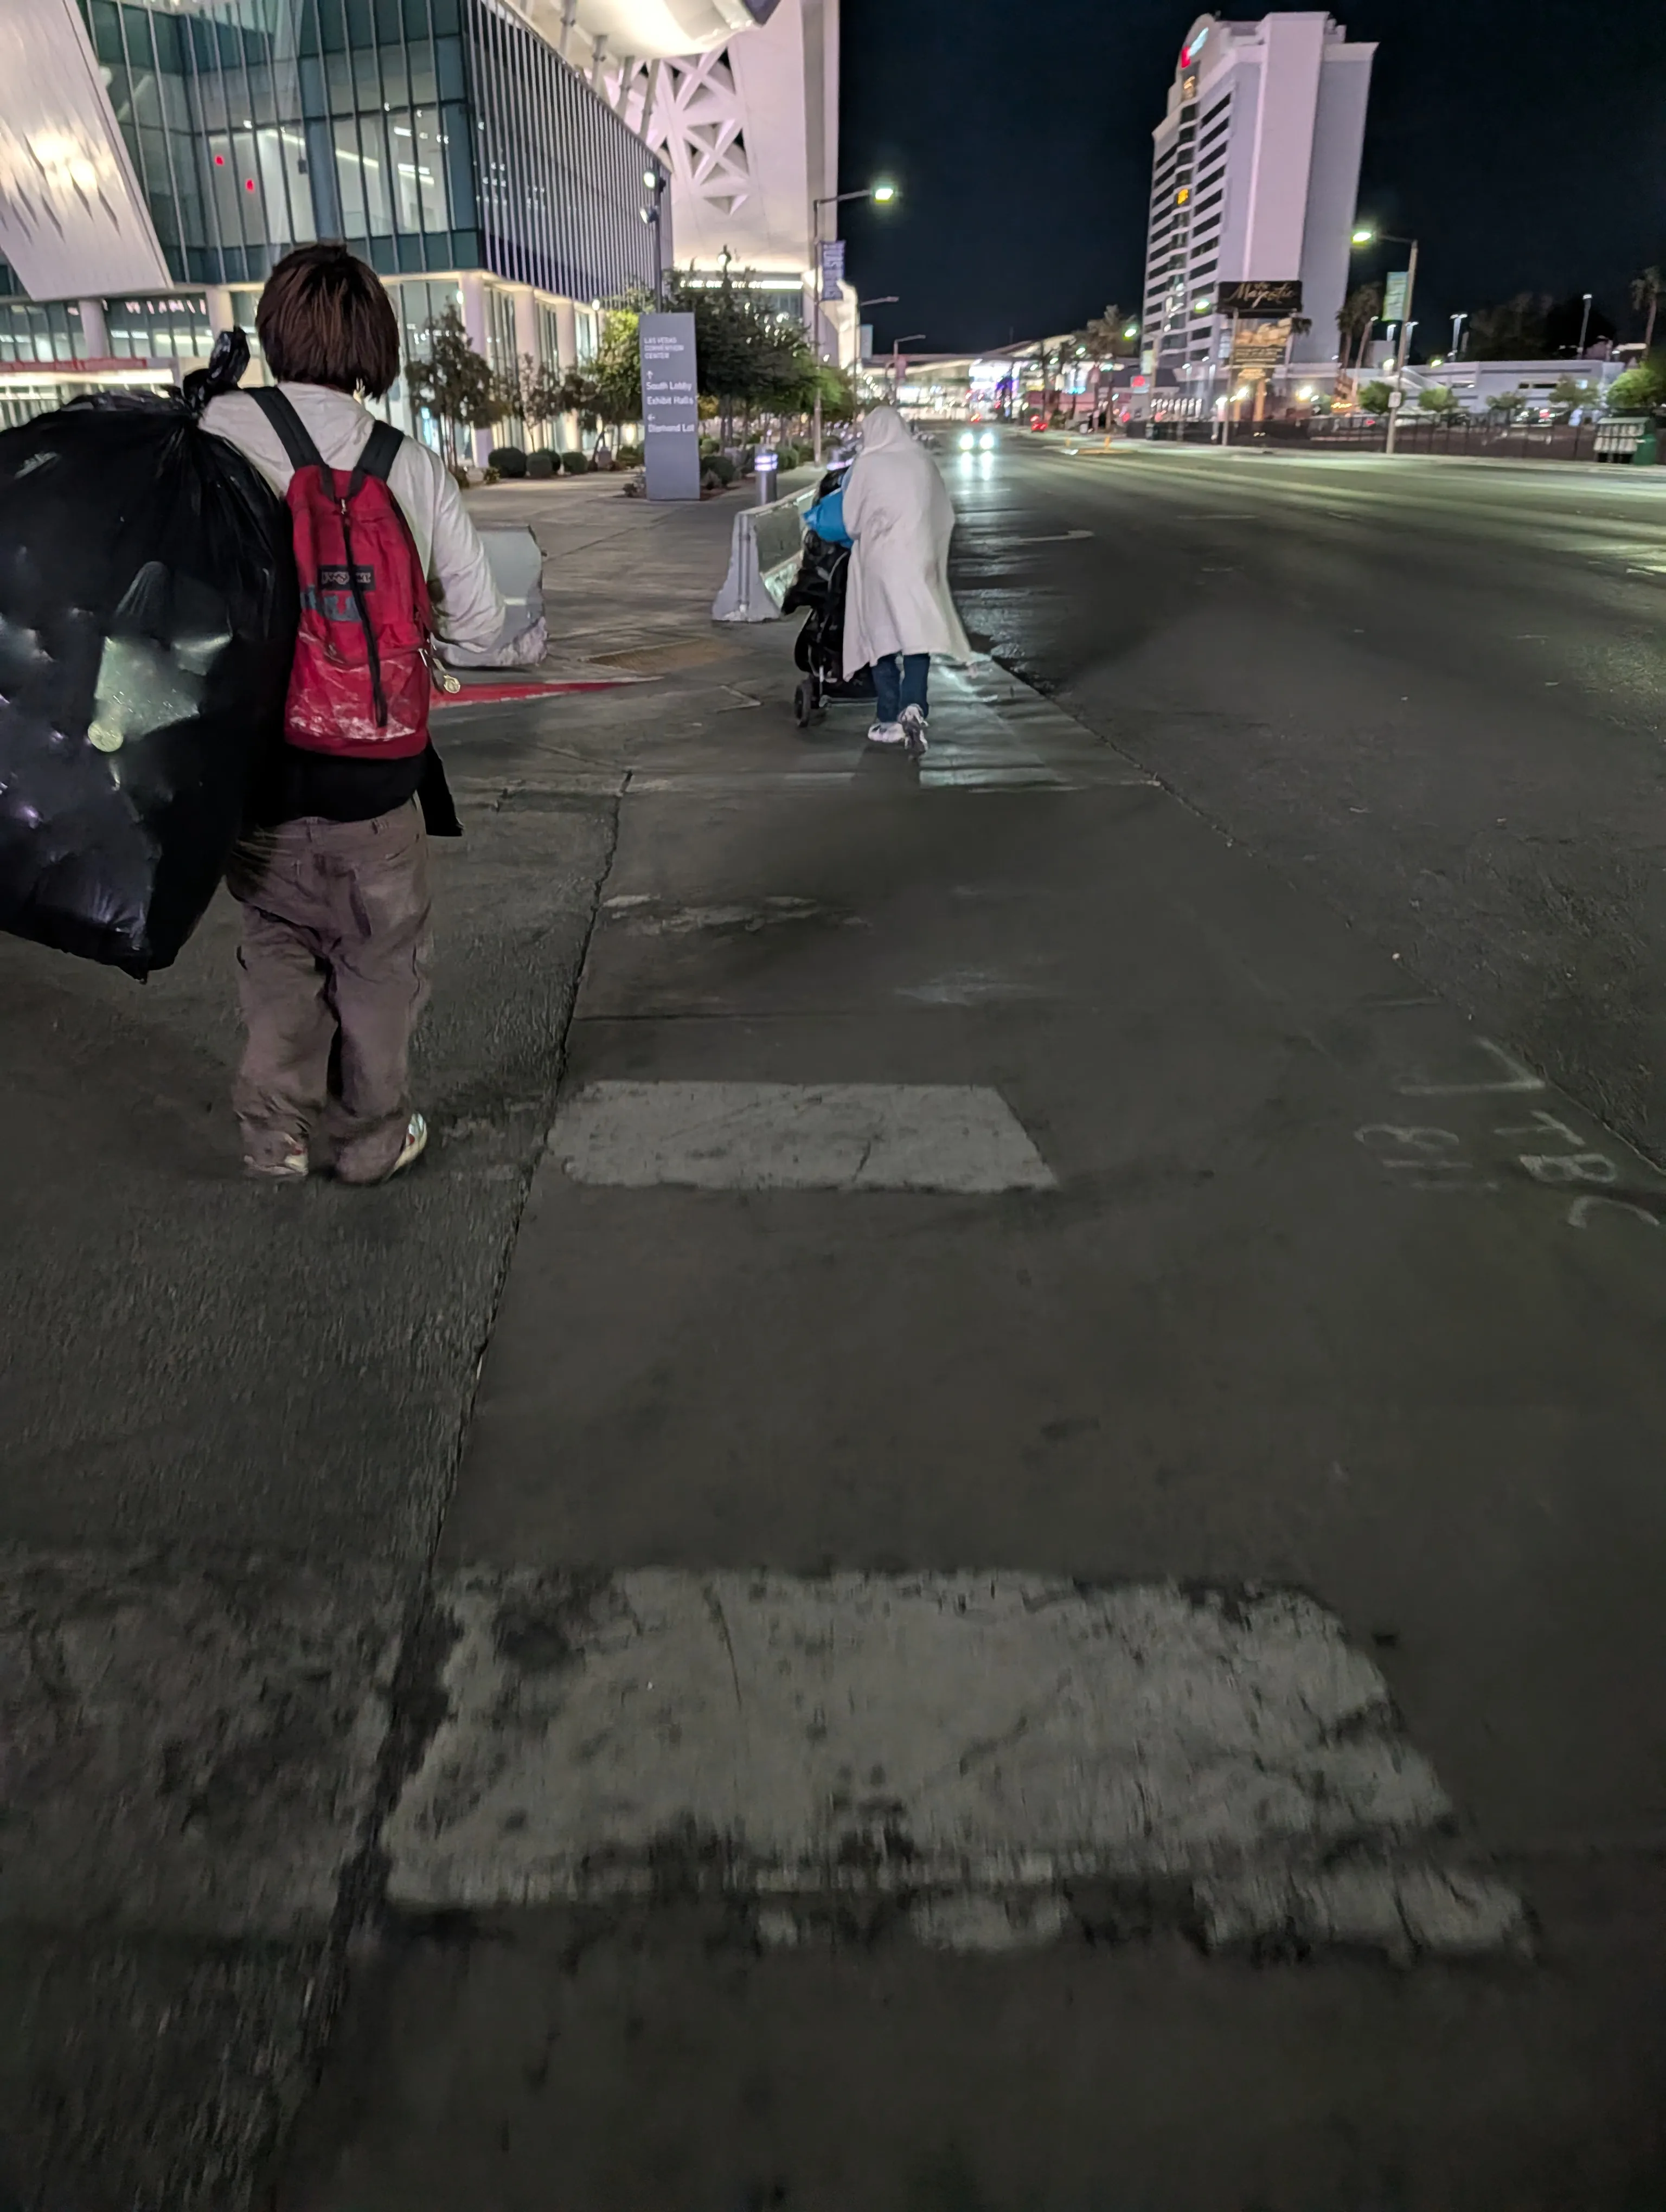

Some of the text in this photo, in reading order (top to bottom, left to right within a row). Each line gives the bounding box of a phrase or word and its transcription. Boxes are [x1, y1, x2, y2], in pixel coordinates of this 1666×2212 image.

[646, 381, 692, 391] South Lobby
[646, 396, 694, 406] Exhibit Halls
[682, 424, 695, 433] Lot
